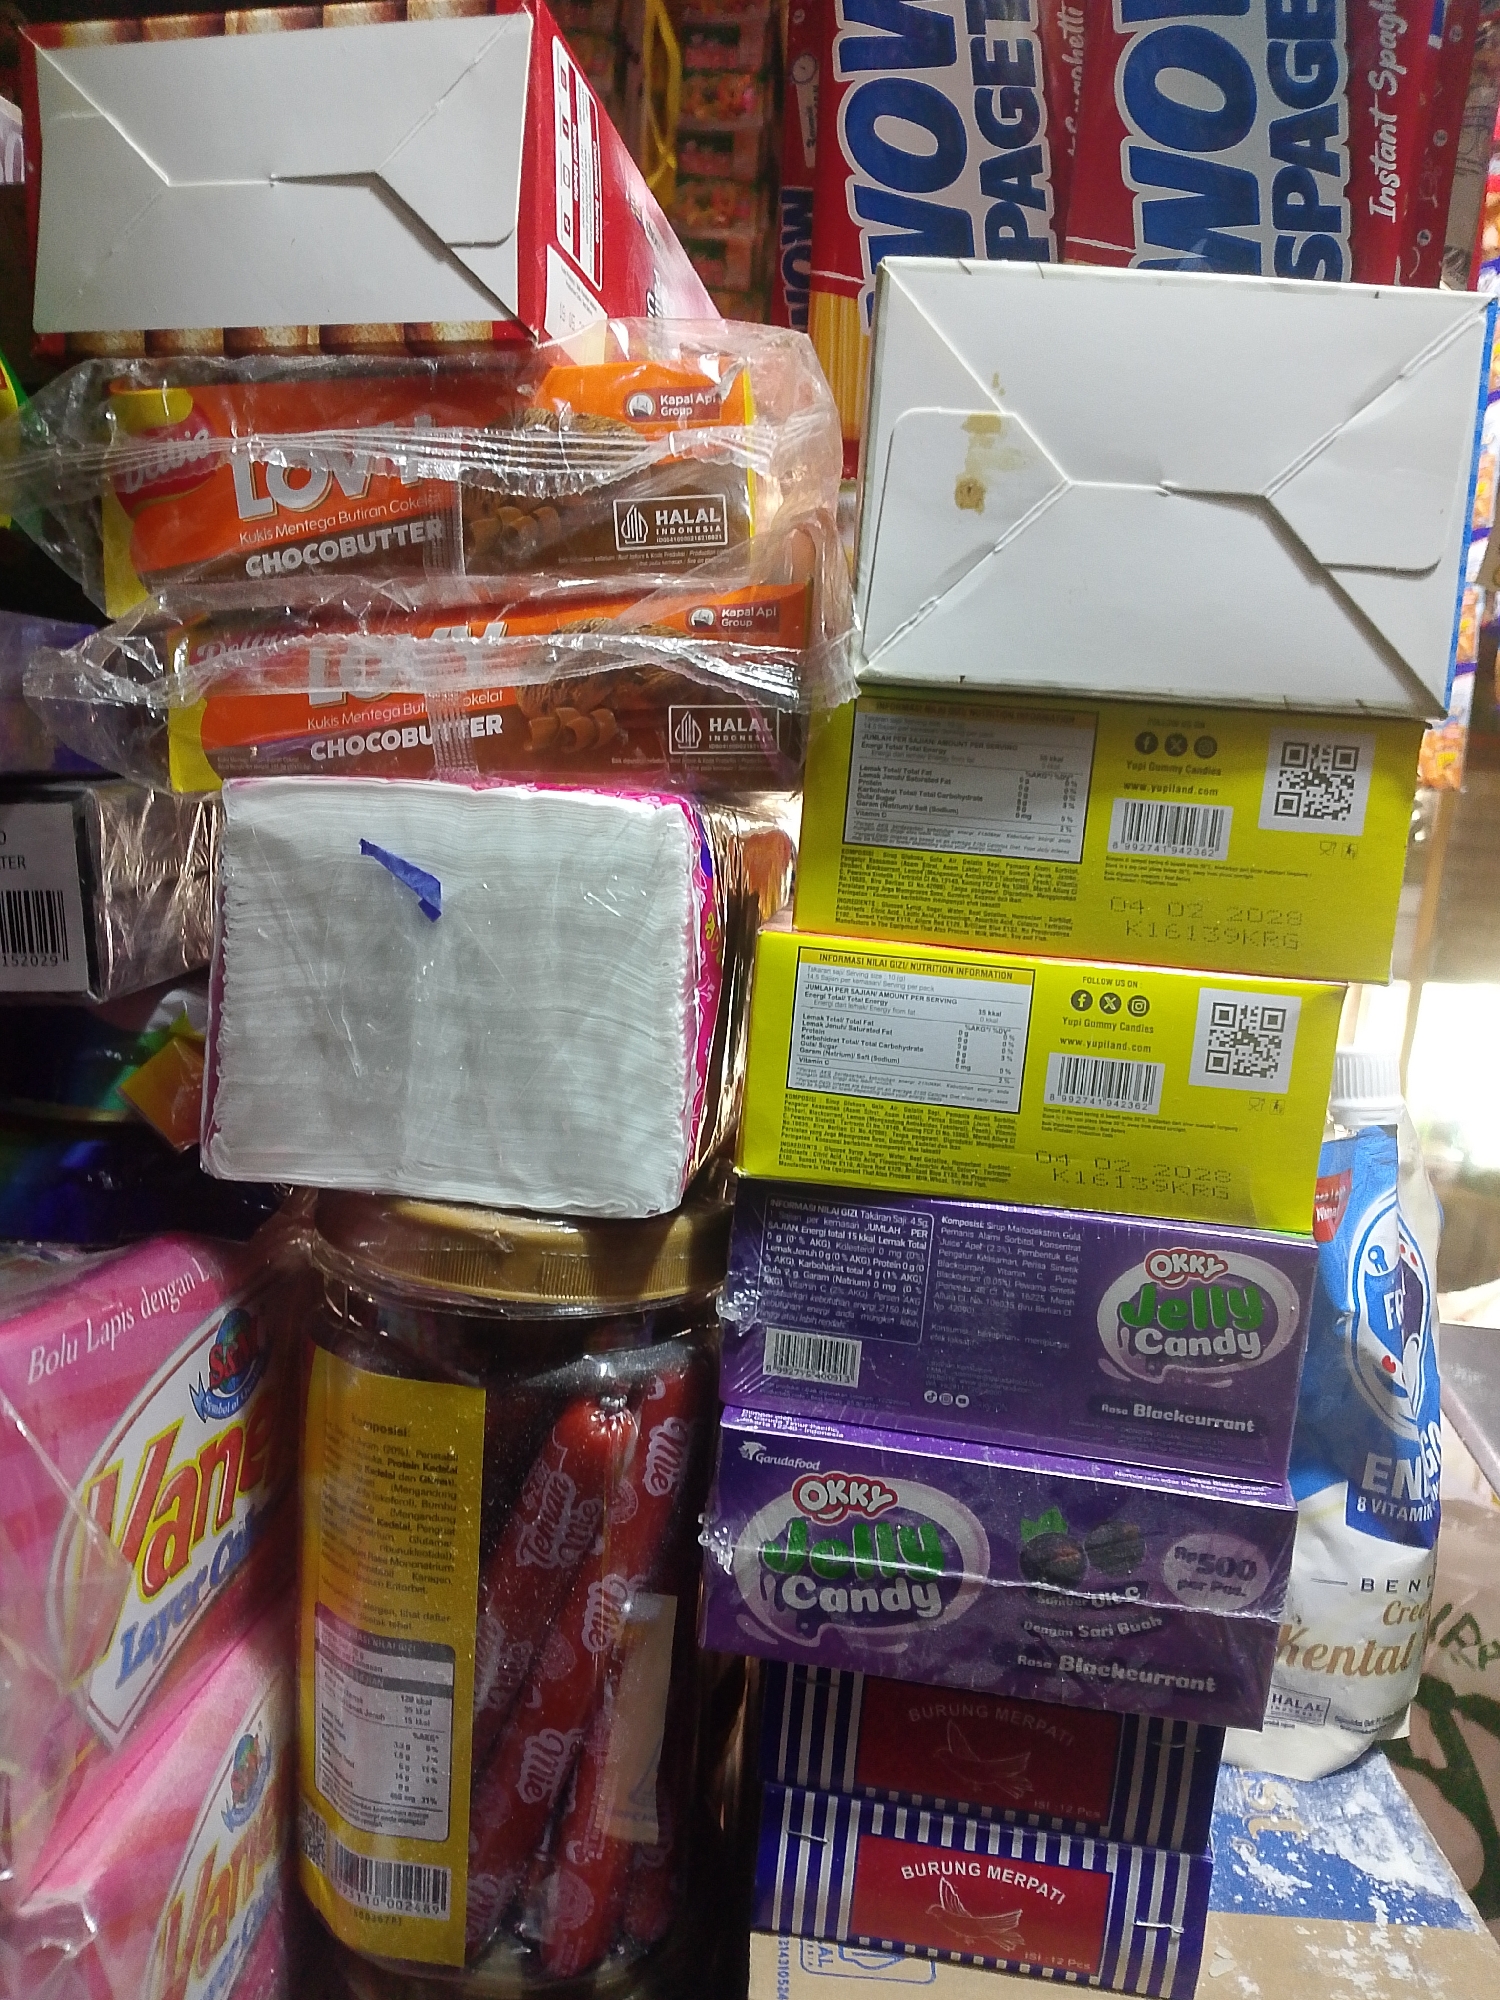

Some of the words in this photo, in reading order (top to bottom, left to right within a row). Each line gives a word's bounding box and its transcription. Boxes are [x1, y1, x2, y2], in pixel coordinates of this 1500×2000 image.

[1368, 93, 1400, 223] Instant
[660, 394, 694, 407] Kapal
[660, 406, 693, 417] Group
[239, 529, 273, 546] Kukis
[275, 516, 336, 540] Mentega
[339, 505, 387, 525] Butiran
[655, 507, 721, 526] HALAL
[656, 526, 722, 536] INDONESIA
[245, 518, 444, 577] CHOCOBUTTER
[721, 606, 755, 619] Kapal
[756, 606, 777, 619] Api
[721, 618, 753, 628] Group
[307, 715, 340, 730] Kukis
[343, 707, 401, 728] Mentega
[1126, 760, 1146, 772] Yupi
[1185, 763, 1222, 777] Candies
[1171, 845, 1214, 858] 942362
[1110, 896, 1145, 915] 04
[1168, 900, 1204, 919] 02
[819, 953, 863, 966] INFORMASI
[866, 958, 887, 968] NILAI
[910, 961, 953, 975] NUTRITION
[956, 966, 1012, 980] INFORMATION
[805, 982, 833, 992] JUMLAH
[834, 986, 849, 994] PER
[879, 990, 910, 1001] AMOUNT
[910, 993, 924, 1002] PER
[925, 995, 957, 1005] SERVING
[1082, 976, 1113, 987] FOLLOW
[1116, 978, 1125, 987] US
[1127, 979, 1139, 988] ON
[847, 995, 863, 1003] Total
[864, 997, 888, 1007] Energy
[987, 1009, 1001, 1017] kkal
[802, 1012, 824, 1022] Lemak
[845, 1017, 861, 1025] Total
[802, 1019, 823, 1028] Lemak
[848, 1024, 880, 1034] Saturated
[881, 1028, 892, 1036] Fat
[1062, 1016, 1082, 1028] Yupi
[1084, 1019, 1117, 1032] Gummy
[1119, 1021, 1154, 1034] Candies
[801, 1026, 825, 1035] Protein
[800, 1033, 840, 1044] Karbohidrat
[861, 1039, 877, 1047] Total
[878, 1041, 924, 1054] Carbohydrate
[1060, 1037, 1152, 1053] www.yupiland.com
[798, 1056, 823, 1065] Vitamin
[1106, 1098, 1149, 1111] 942362
[1095, 1157, 1131, 1173] 02
[1153, 1163, 1232, 1183] 2028
[769, 1198, 815, 1213] INFORMASI
[817, 1204, 839, 1216] NILAI
[860, 1209, 891, 1222] Takaran
[800, 1225, 825, 1238] Energi
[827, 1229, 845, 1239] total
[878, 1235, 905, 1247] Lemak
[907, 1239, 926, 1250] Total
[823, 1217, 859, 1230] kemasan
[865, 1222, 900, 1235] JUMLAH
[910, 1228, 928, 1239] PER
[765, 1242, 791, 1254] Lemak
[792, 1246, 817, 1258] Jenuh
[872, 1257, 900, 1269] Protein
[798, 1258, 844, 1273] Karbohidrat
[1149, 1253, 1224, 1279] OKKY
[1119, 1283, 1263, 1331] Jelly
[27, 1339, 79, 1385] Bolu
[86, 1301, 135, 1355] Lapis
[140, 1270, 196, 1320] dengan
[1134, 1328, 1261, 1359] Candy
[1101, 1403, 1128, 1415] Rasa
[1133, 1403, 1255, 1432] Blackcurrant
[387, 1458, 419, 1470] Protein
[423, 1462, 458, 1475] Kedelai
[650, 1422, 688, 1491] Mie
[755, 1453, 821, 1471] Garudafood
[800, 1480, 892, 1512] OKKY
[1357, 1496, 1366, 1512] 8
[762, 1518, 945, 1581] Jelly
[782, 1575, 942, 1618] Candy
[1078, 1625, 1115, 1639] Sari
[1117, 1616, 1162, 1635] Buah
[1276, 1624, 1417, 1677] Kental
[1017, 1655, 1052, 1669] Rasa
[1058, 1655, 1216, 1693] Blackcurrant
[1272, 1693, 1324, 1712] HALAL
[908, 1704, 989, 1723] BURUNG
[995, 1708, 1076, 1748] MERPATI
[524, 1734, 565, 1800] Mie
[900, 1861, 982, 1882] BURUNG
[987, 1865, 1066, 1905] MERPATI
